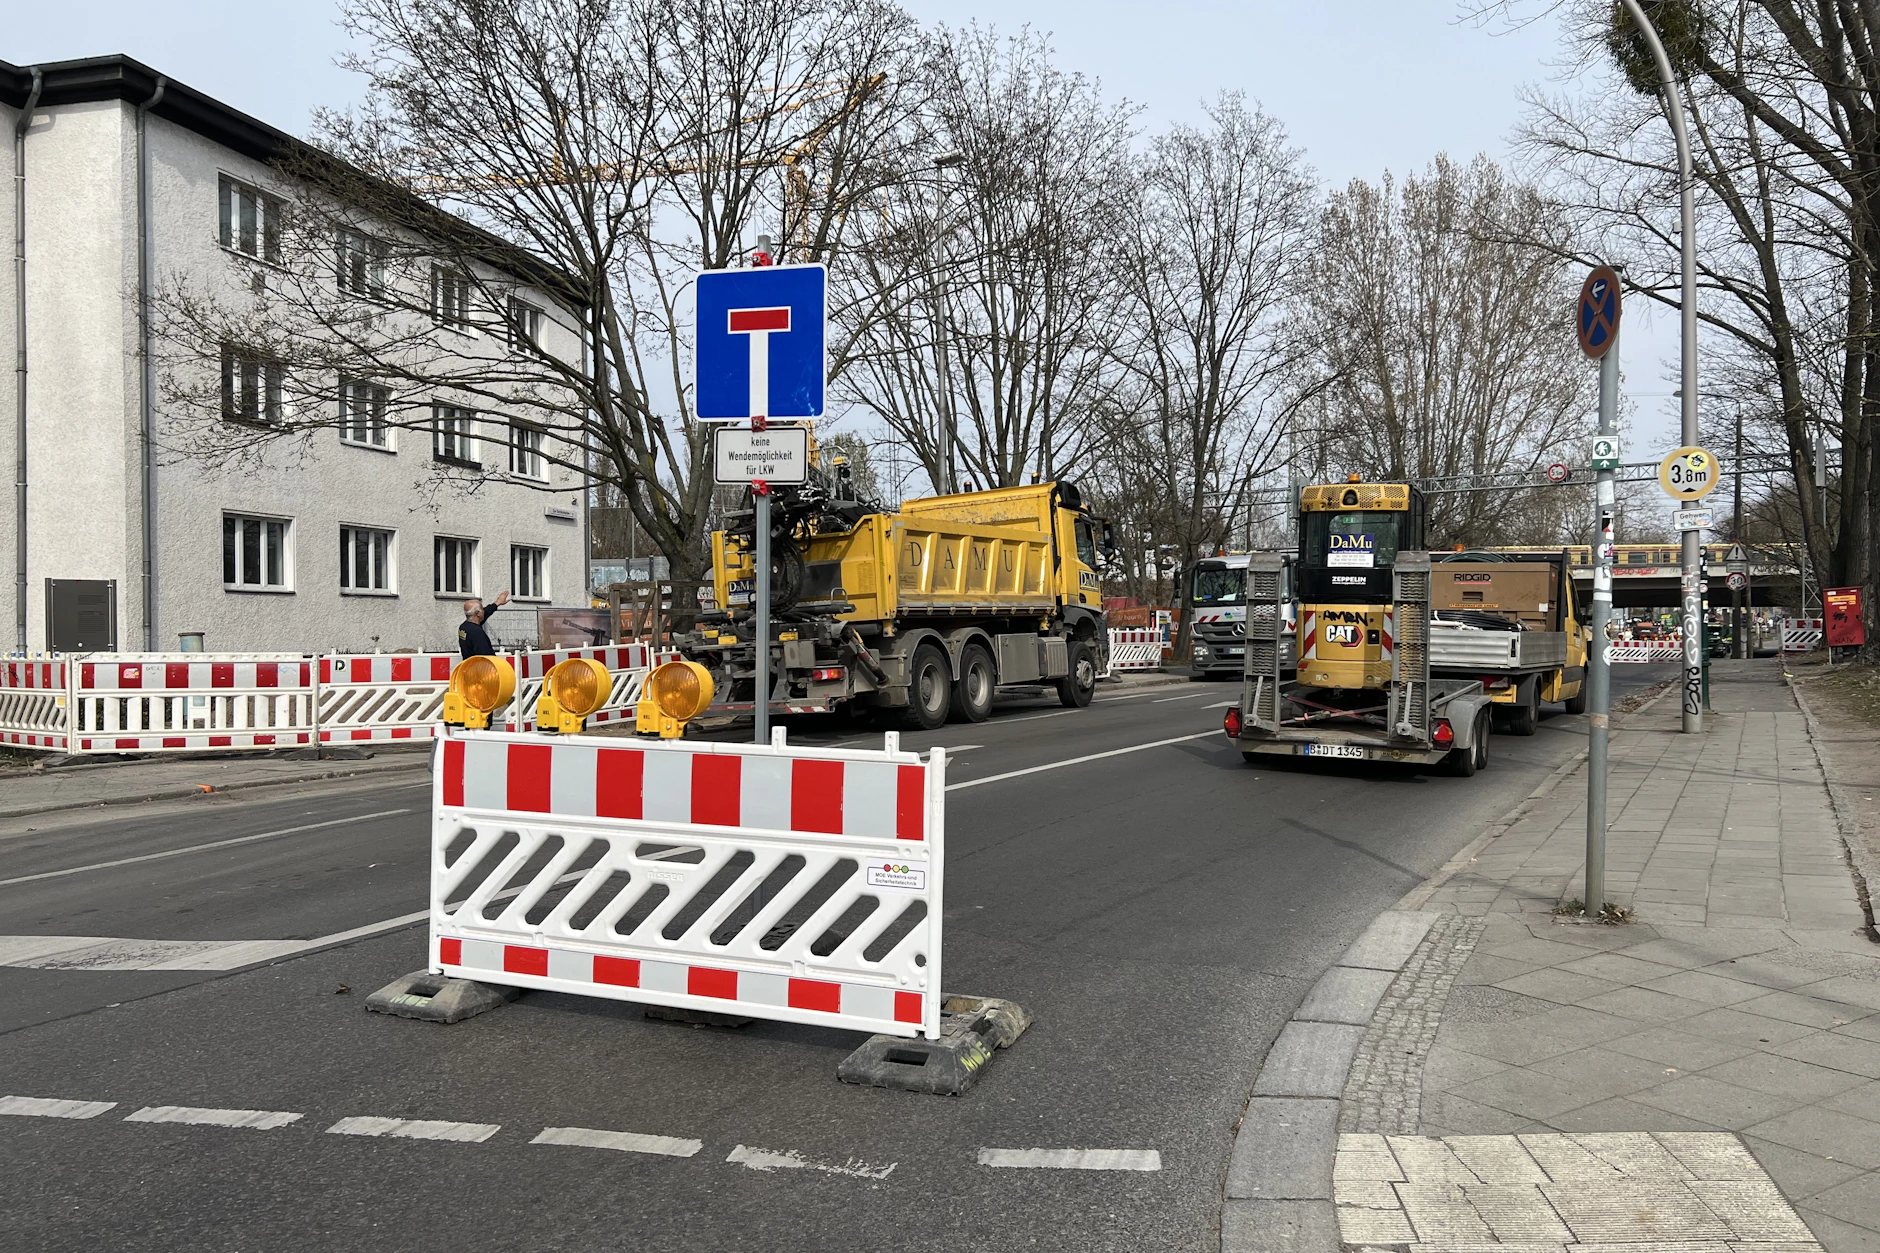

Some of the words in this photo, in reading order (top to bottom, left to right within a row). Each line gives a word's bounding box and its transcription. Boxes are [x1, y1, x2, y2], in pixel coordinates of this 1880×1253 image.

[751, 436, 770, 446] keine
[728, 450, 793, 463] Wendemöglichkeit
[746, 465, 757, 475] für
[759, 465, 774, 475] LKW
[1330, 534, 1373, 549] DaMu
[1454, 573, 1491, 582] RIDGID
[1730, 576, 1743, 586] 30
[1326, 625, 1355, 643] CAT
[1309, 745, 1316, 754] B
[1322, 746, 1336, 756] DT
[1337, 747, 1362, 757] 1345
[647, 865, 684, 881] nissen
[875, 878, 917, 886] Sicherheitstechnik
[390, 993, 433, 1007] MOE
[960, 1040, 991, 1072] MOE
